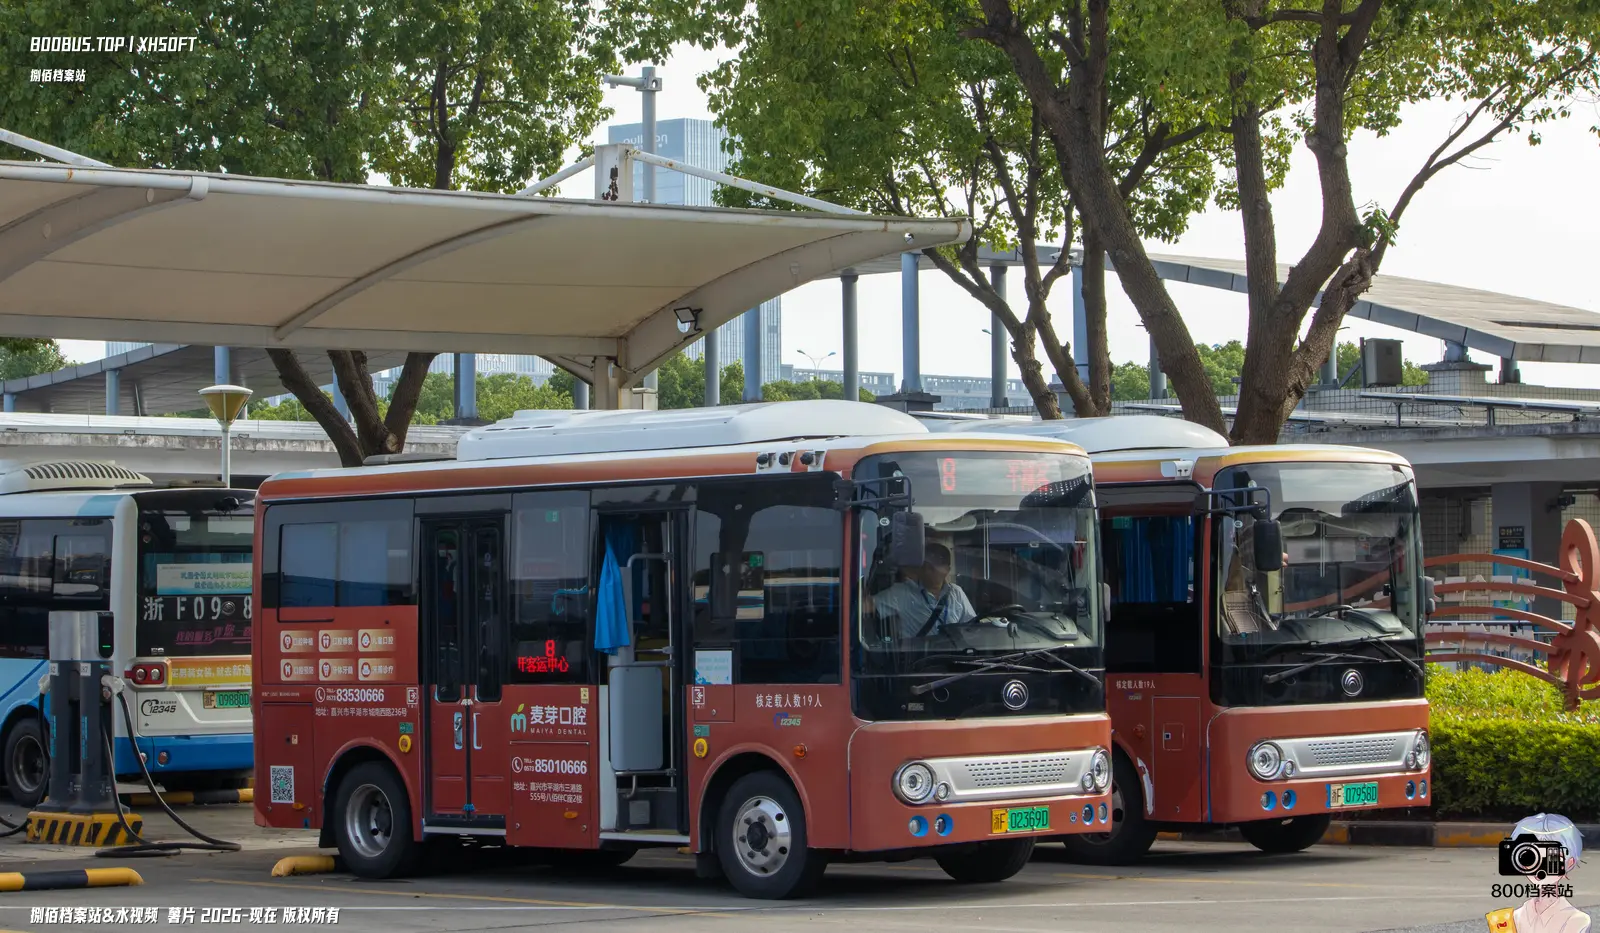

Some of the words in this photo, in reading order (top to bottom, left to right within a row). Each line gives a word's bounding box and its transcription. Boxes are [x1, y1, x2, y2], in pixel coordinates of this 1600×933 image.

[942, 458, 956, 491] 8
[545, 640, 555, 656] 8
[336, 688, 385, 702] 83530666
[755, 693, 823, 708] 核定载人数19人
[530, 705, 587, 725] 麦芽口腔
[530, 727, 553, 735] MAIYA
[558, 728, 587, 736] DENTAL
[535, 758, 587, 774] 85010666
